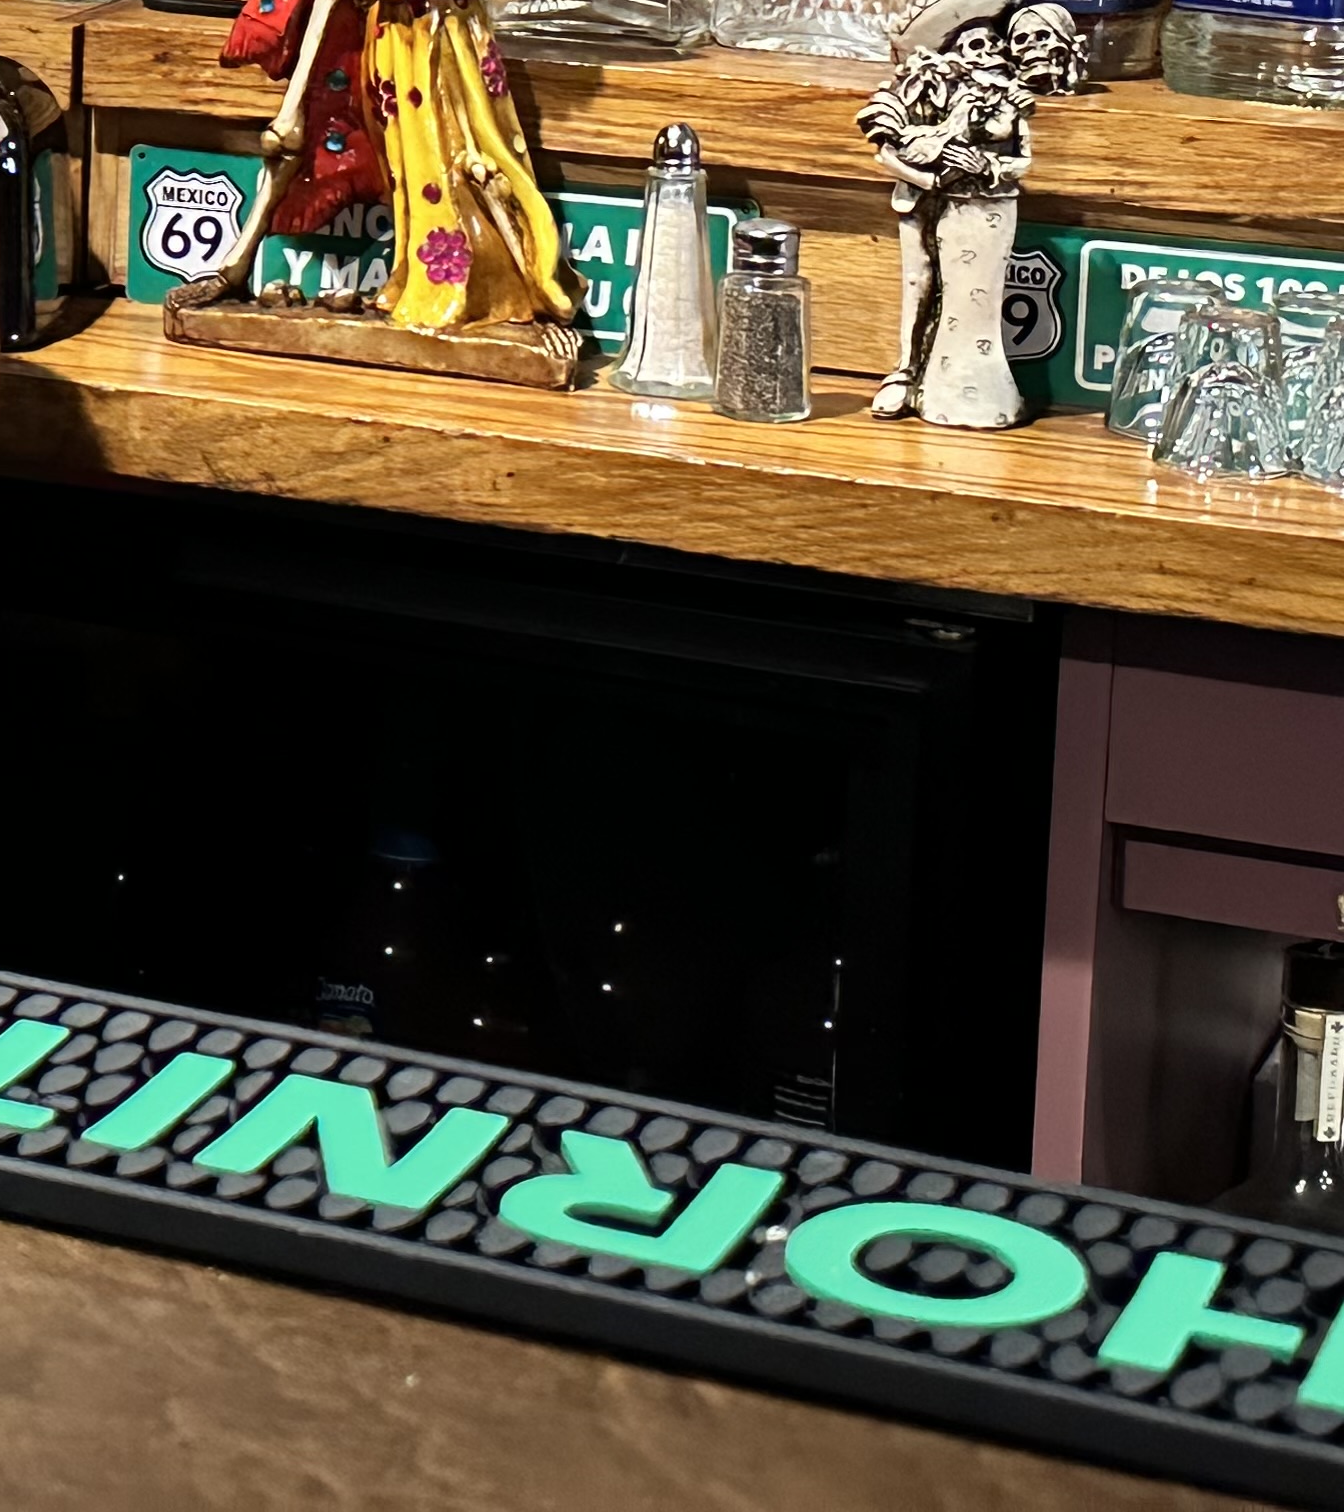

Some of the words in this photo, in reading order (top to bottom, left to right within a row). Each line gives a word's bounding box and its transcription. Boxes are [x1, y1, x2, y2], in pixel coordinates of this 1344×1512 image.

[163, 185, 229, 207] MEXICO
[161, 212, 223, 264] 69
[282, 247, 313, 286] Y
[320, 247, 392, 292] MÁ
[1002, 293, 1039, 346] 9
